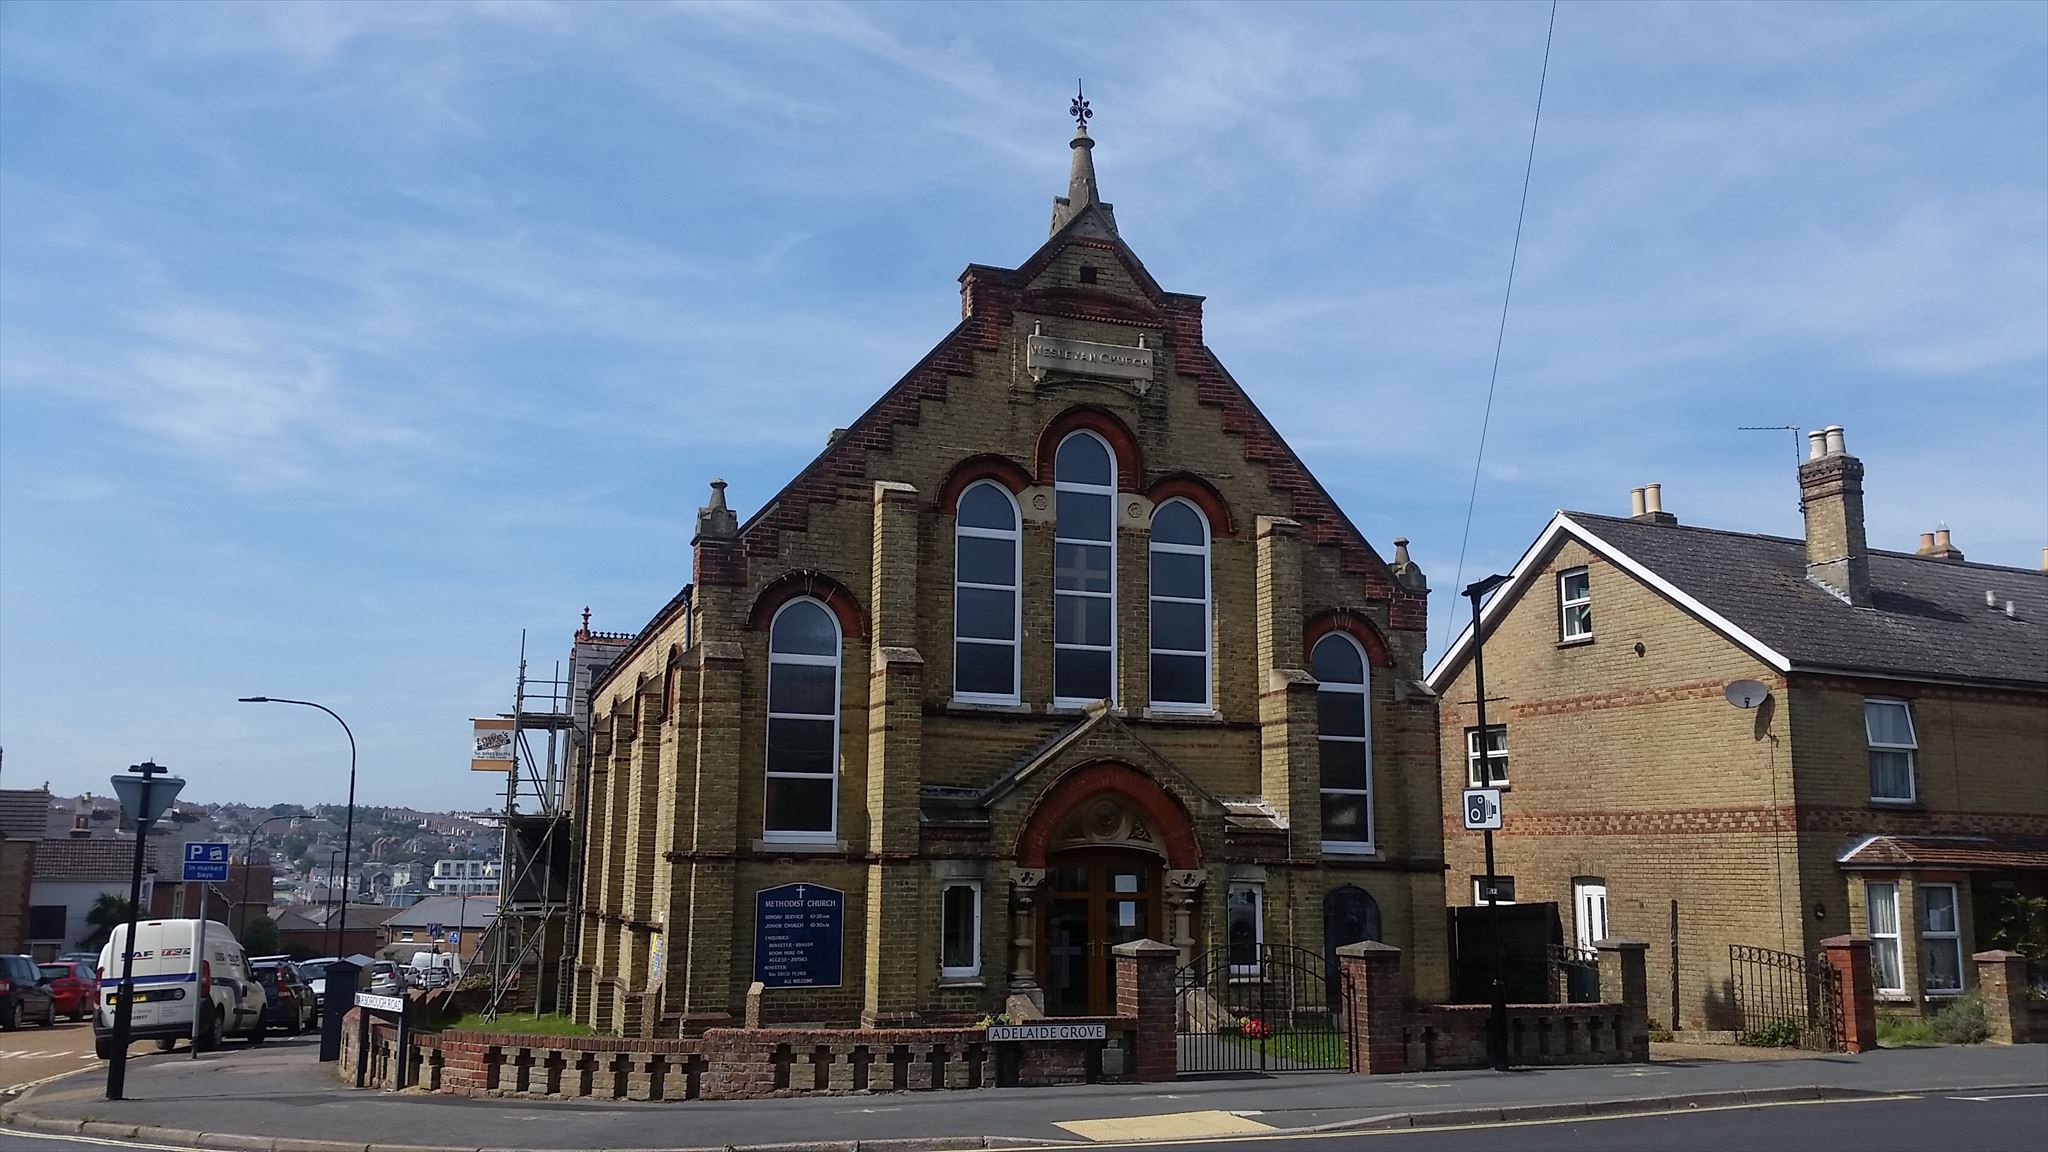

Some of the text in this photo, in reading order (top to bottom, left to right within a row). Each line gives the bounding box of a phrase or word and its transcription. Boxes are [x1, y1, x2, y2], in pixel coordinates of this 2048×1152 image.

[1030, 345, 1149, 367] WESLEYAN CHURCH
[191, 845, 203, 860] P
[765, 899, 836, 908] METHODIST CHURCH
[387, 998, 402, 1011] ROAD
[992, 1026, 1103, 1040] ADELAIDE GROVE
